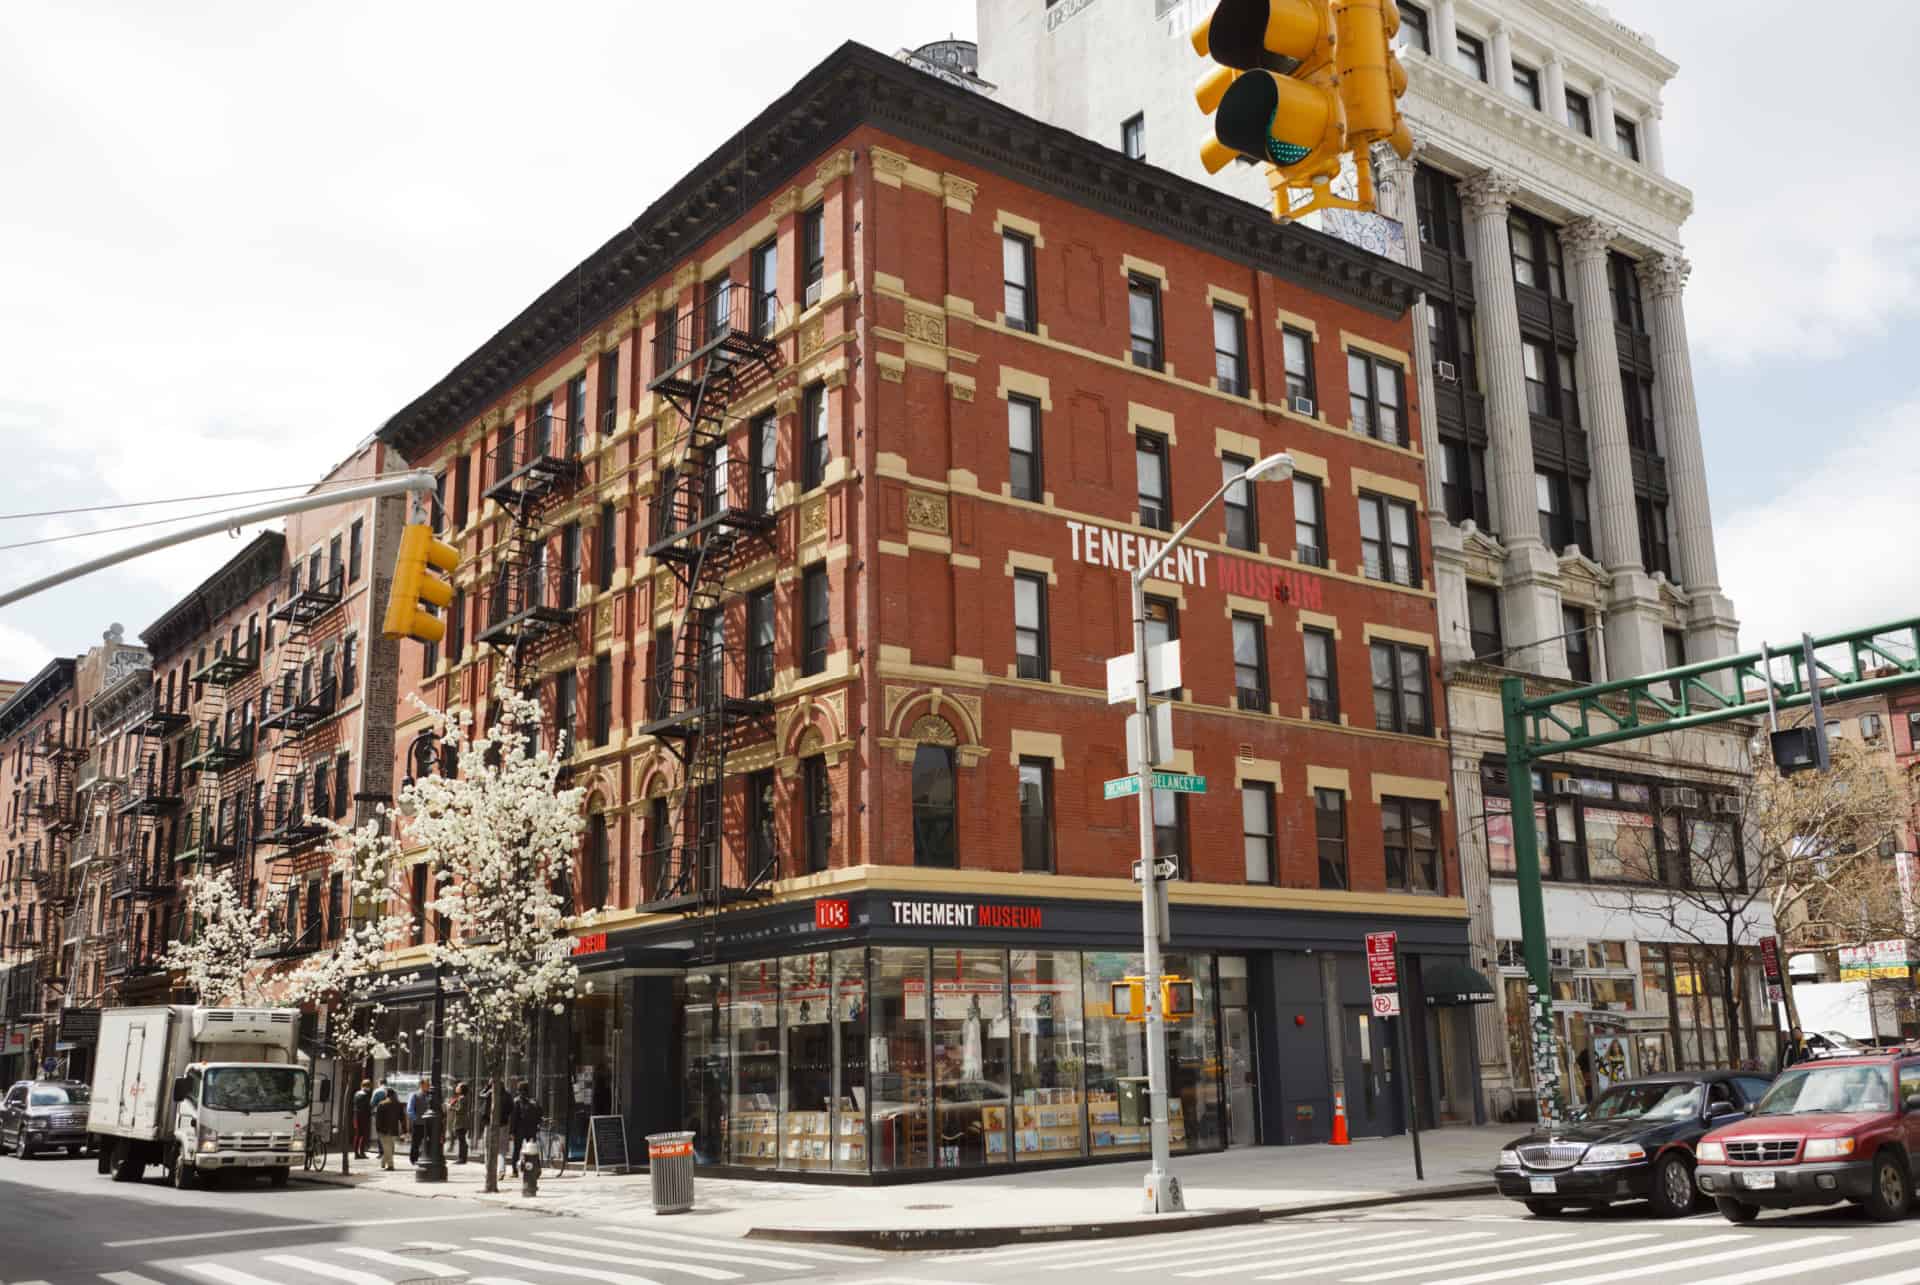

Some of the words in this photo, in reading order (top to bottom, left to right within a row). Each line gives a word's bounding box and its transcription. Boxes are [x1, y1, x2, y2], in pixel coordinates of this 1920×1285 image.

[1066, 520, 1209, 587] TENEMENT
[1217, 555, 1322, 610] MUSEUM
[1152, 773, 1194, 791] DELANCEY
[818, 902, 845, 927] 103
[892, 901, 975, 928] TENEMENT
[978, 904, 1042, 930] MUSEUM
